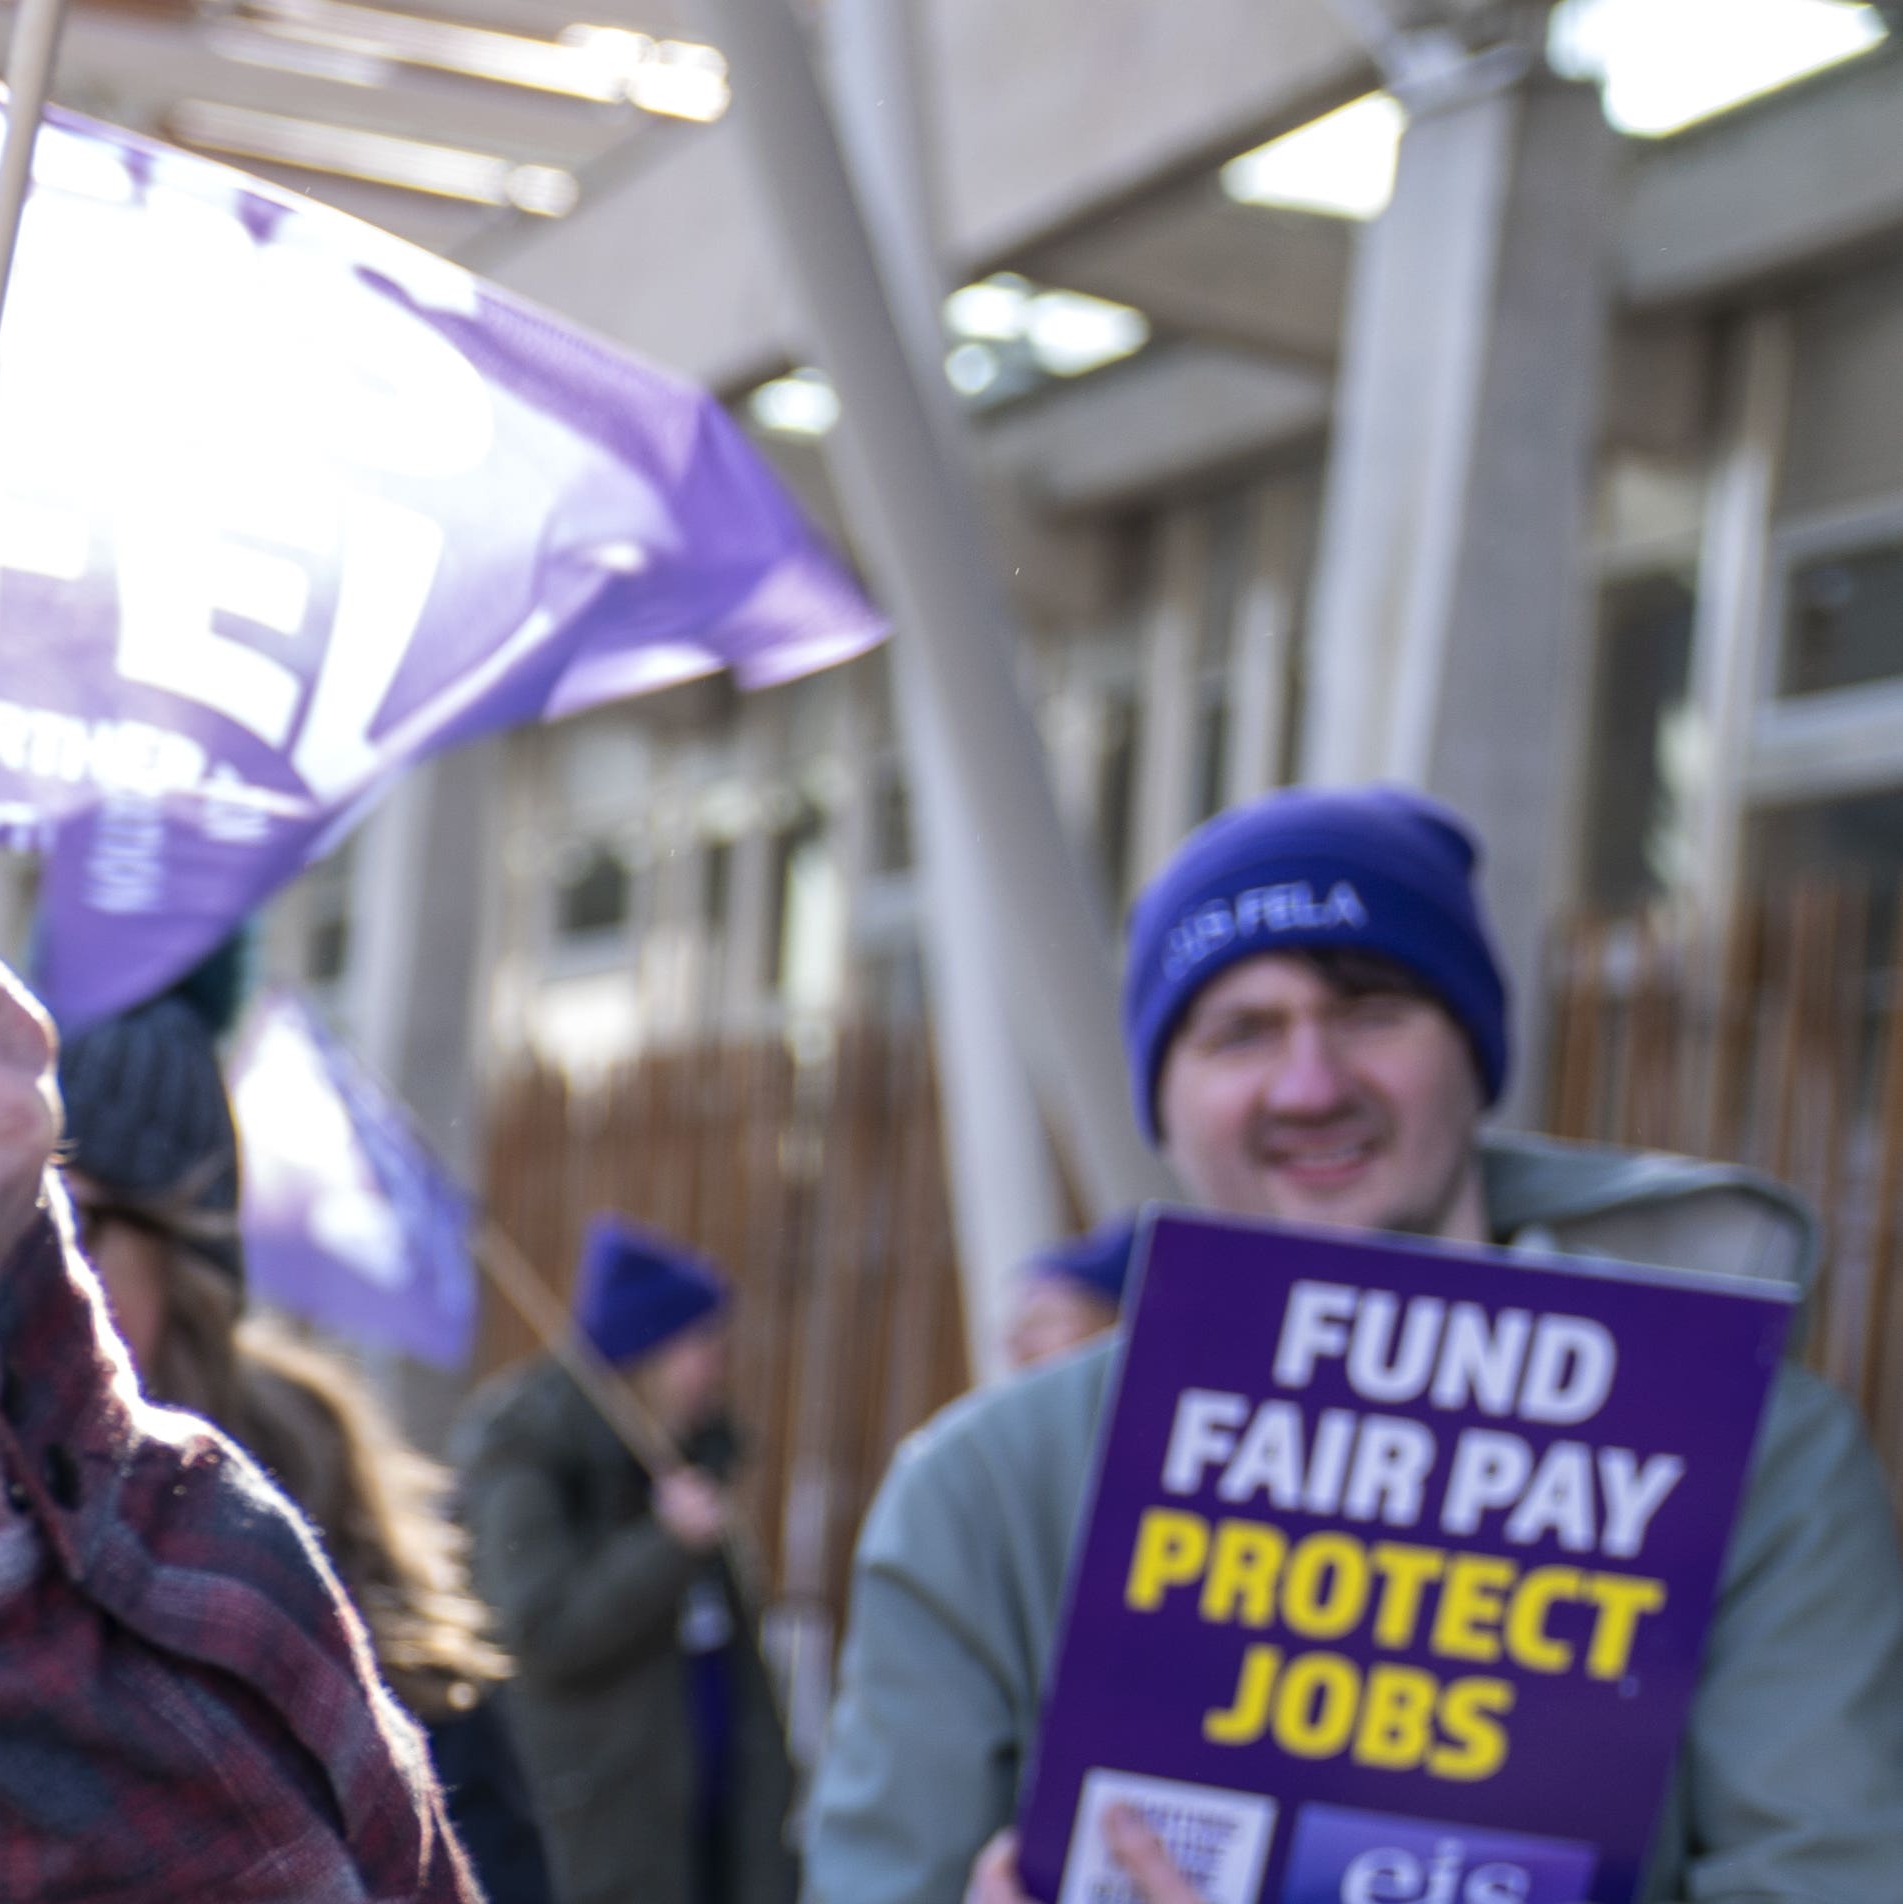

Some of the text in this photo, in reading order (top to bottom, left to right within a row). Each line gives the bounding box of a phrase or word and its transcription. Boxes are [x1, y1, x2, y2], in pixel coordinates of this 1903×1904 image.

[1273, 1278, 1617, 1424] FUND
[1160, 1389, 1685, 1559] FAIR PAY
[1125, 1507, 1667, 1680] PROTECT
[1203, 1646, 1515, 1782] JOBS
